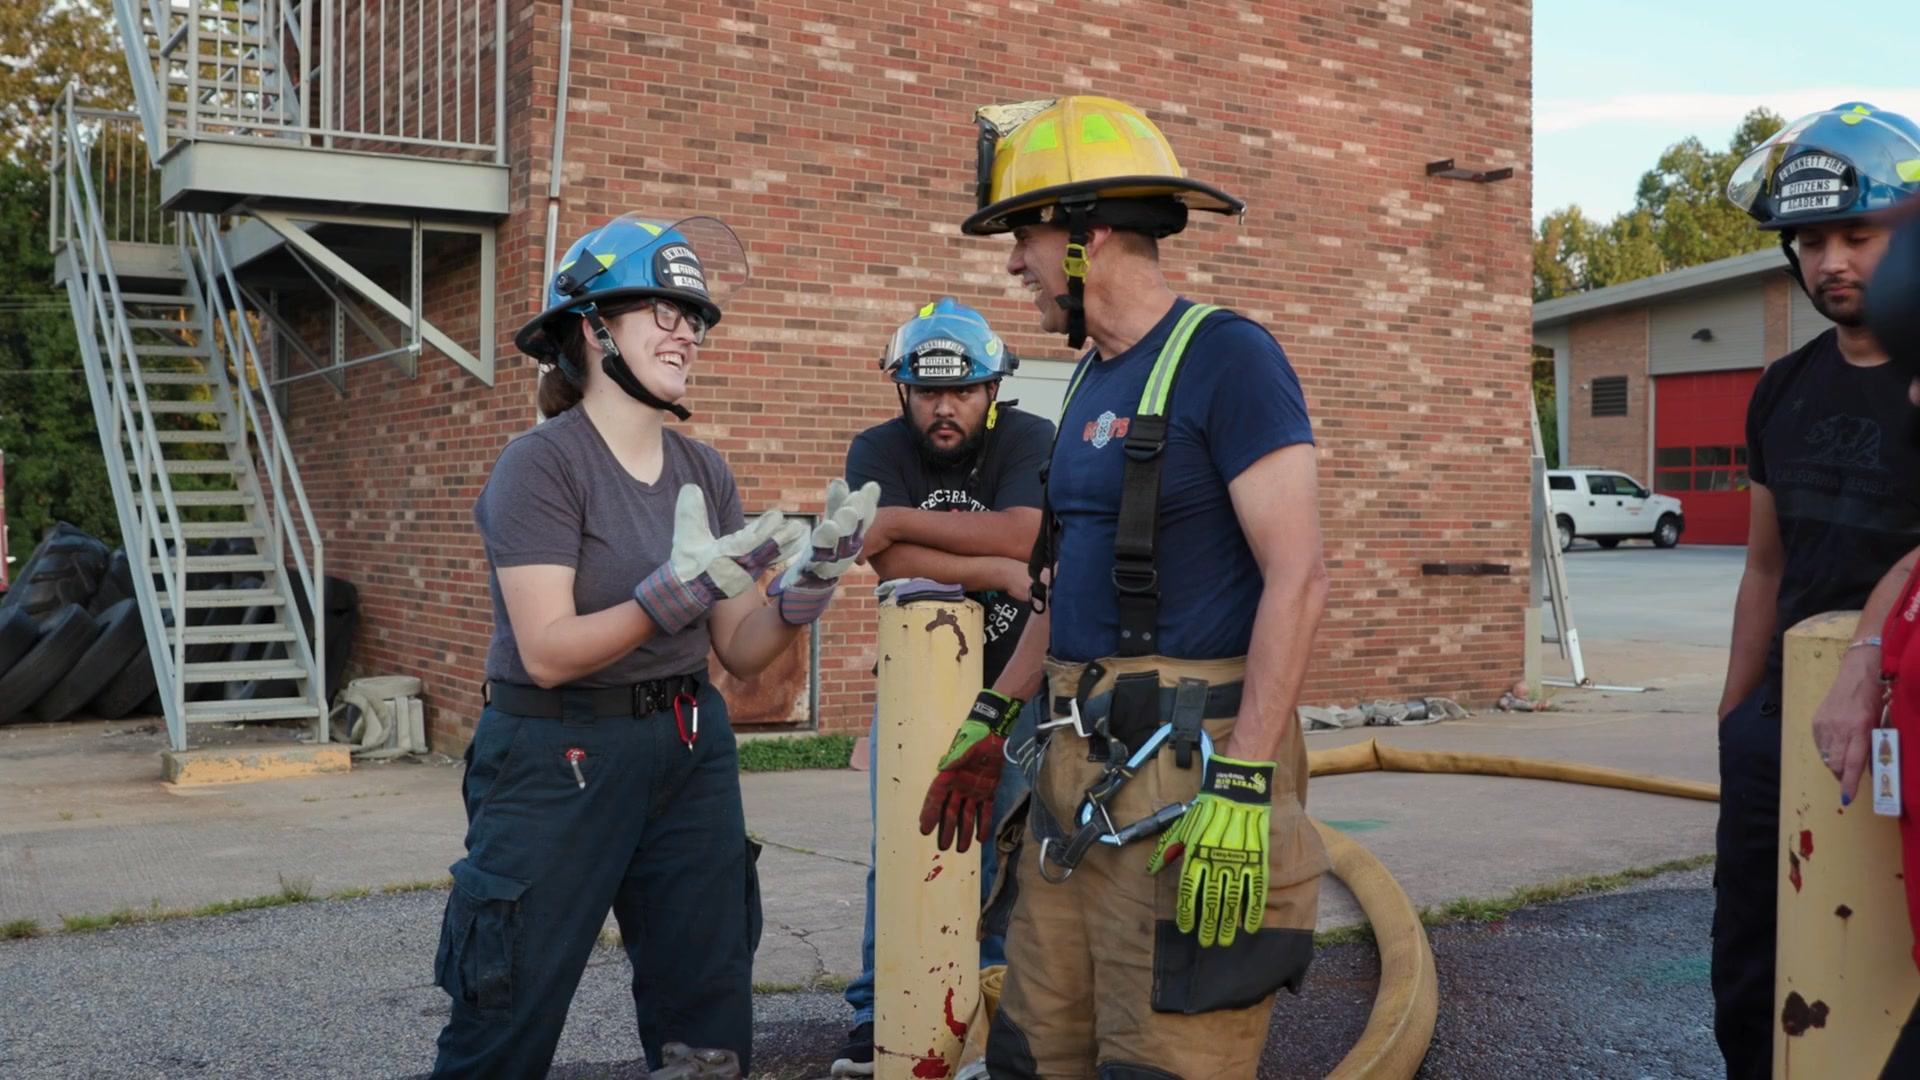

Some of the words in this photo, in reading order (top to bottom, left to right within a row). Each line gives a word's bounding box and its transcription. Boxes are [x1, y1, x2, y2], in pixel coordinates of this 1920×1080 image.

[1779, 156, 1821, 180] GWINNETT
[1824, 157, 1844, 174] FIRE
[1789, 180, 1830, 195] CITIZENS
[1788, 196, 1830, 210] ACADEMY
[925, 357, 953, 365] CITIZENS
[925, 367, 954, 375] ACADEMY
